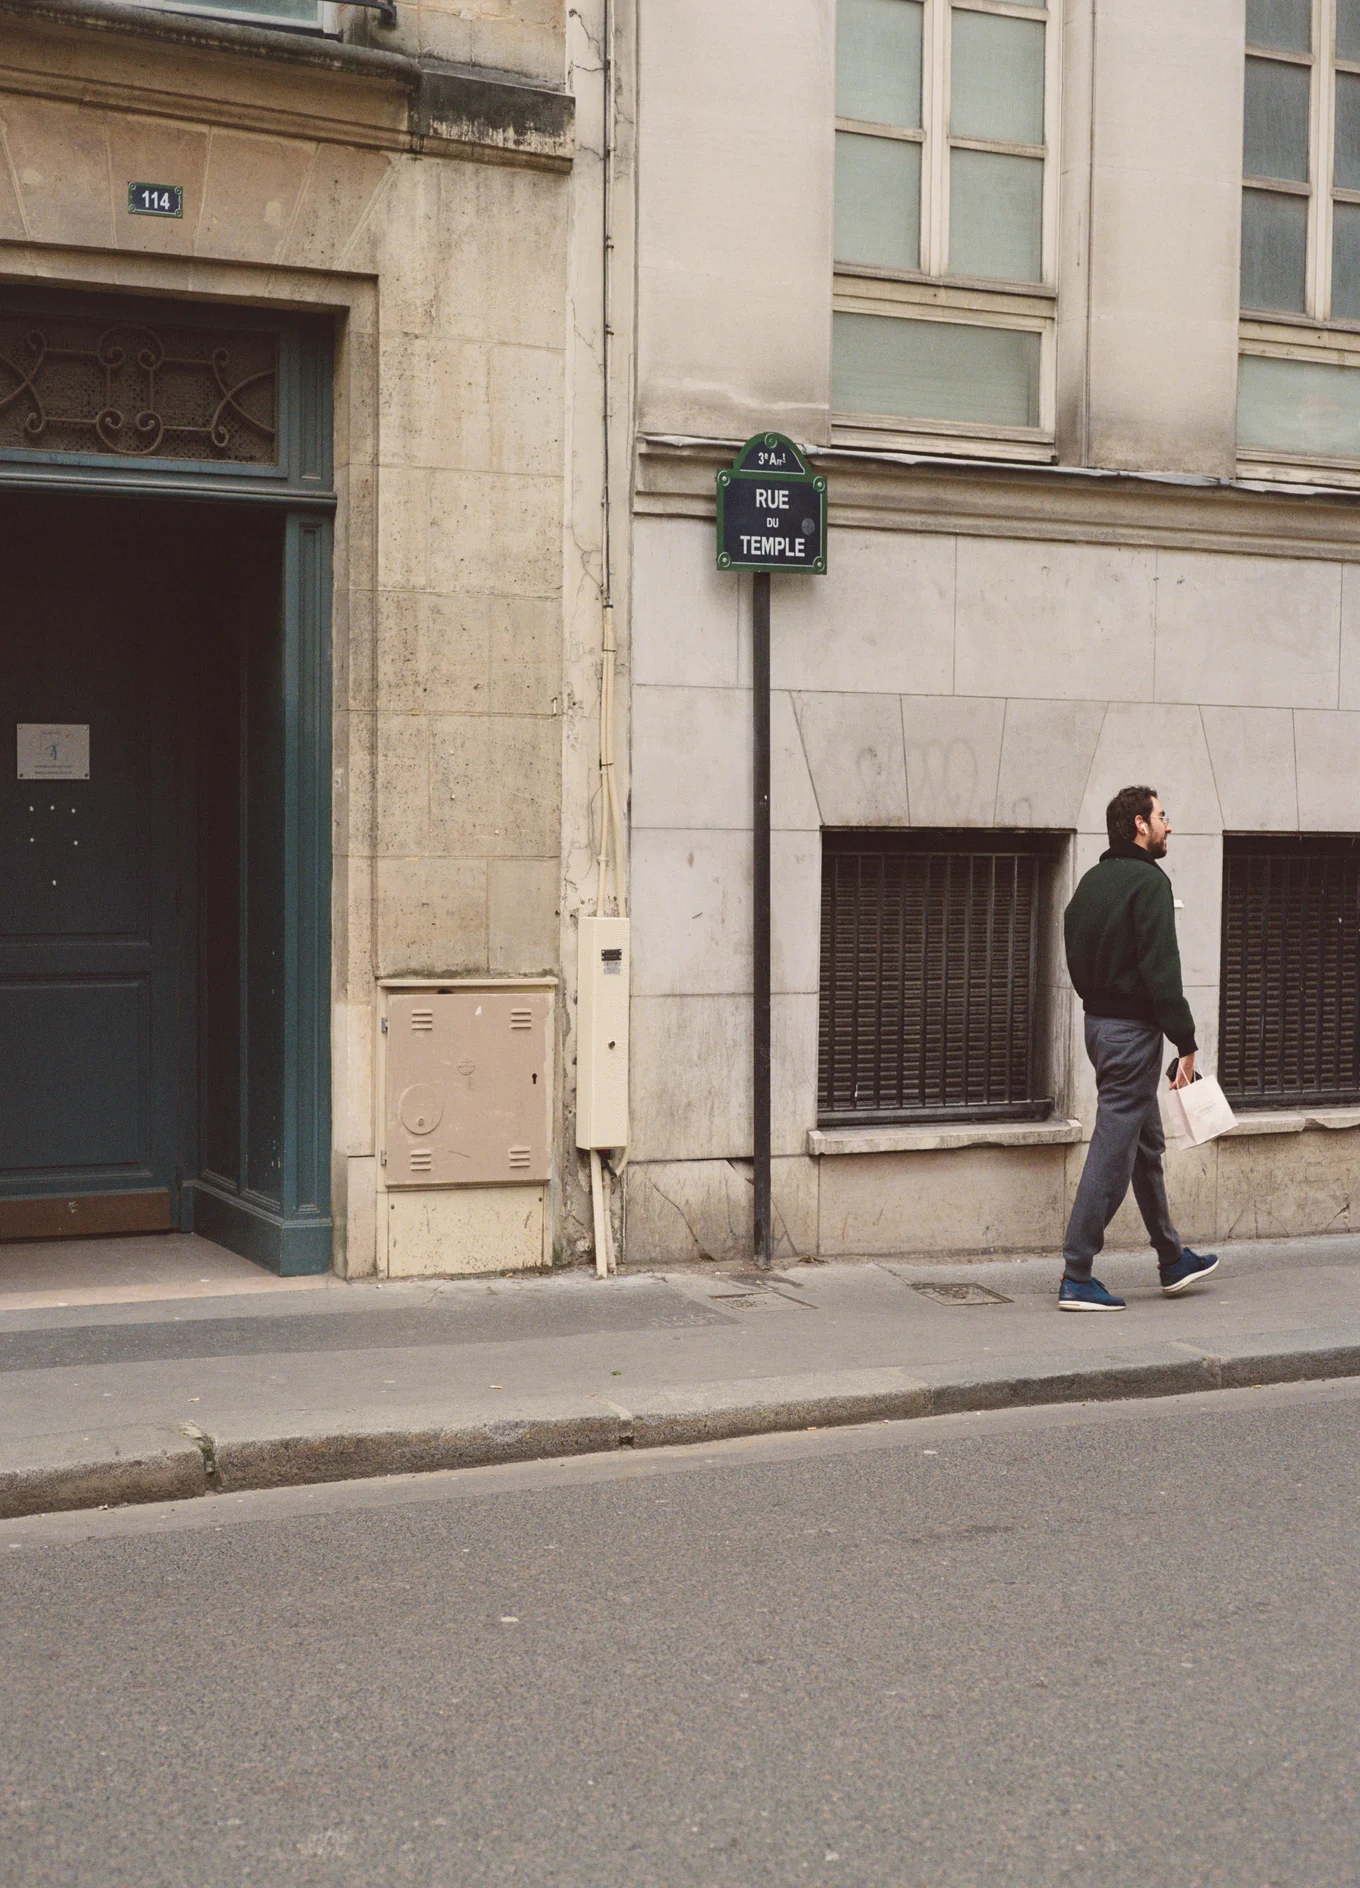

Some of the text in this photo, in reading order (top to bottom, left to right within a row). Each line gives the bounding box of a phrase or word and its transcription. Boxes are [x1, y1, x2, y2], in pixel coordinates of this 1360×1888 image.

[141, 190, 170, 210] 114
[755, 488, 790, 509] RUE
[766, 517, 779, 528] DU
[739, 535, 806, 557] TEMPLE
